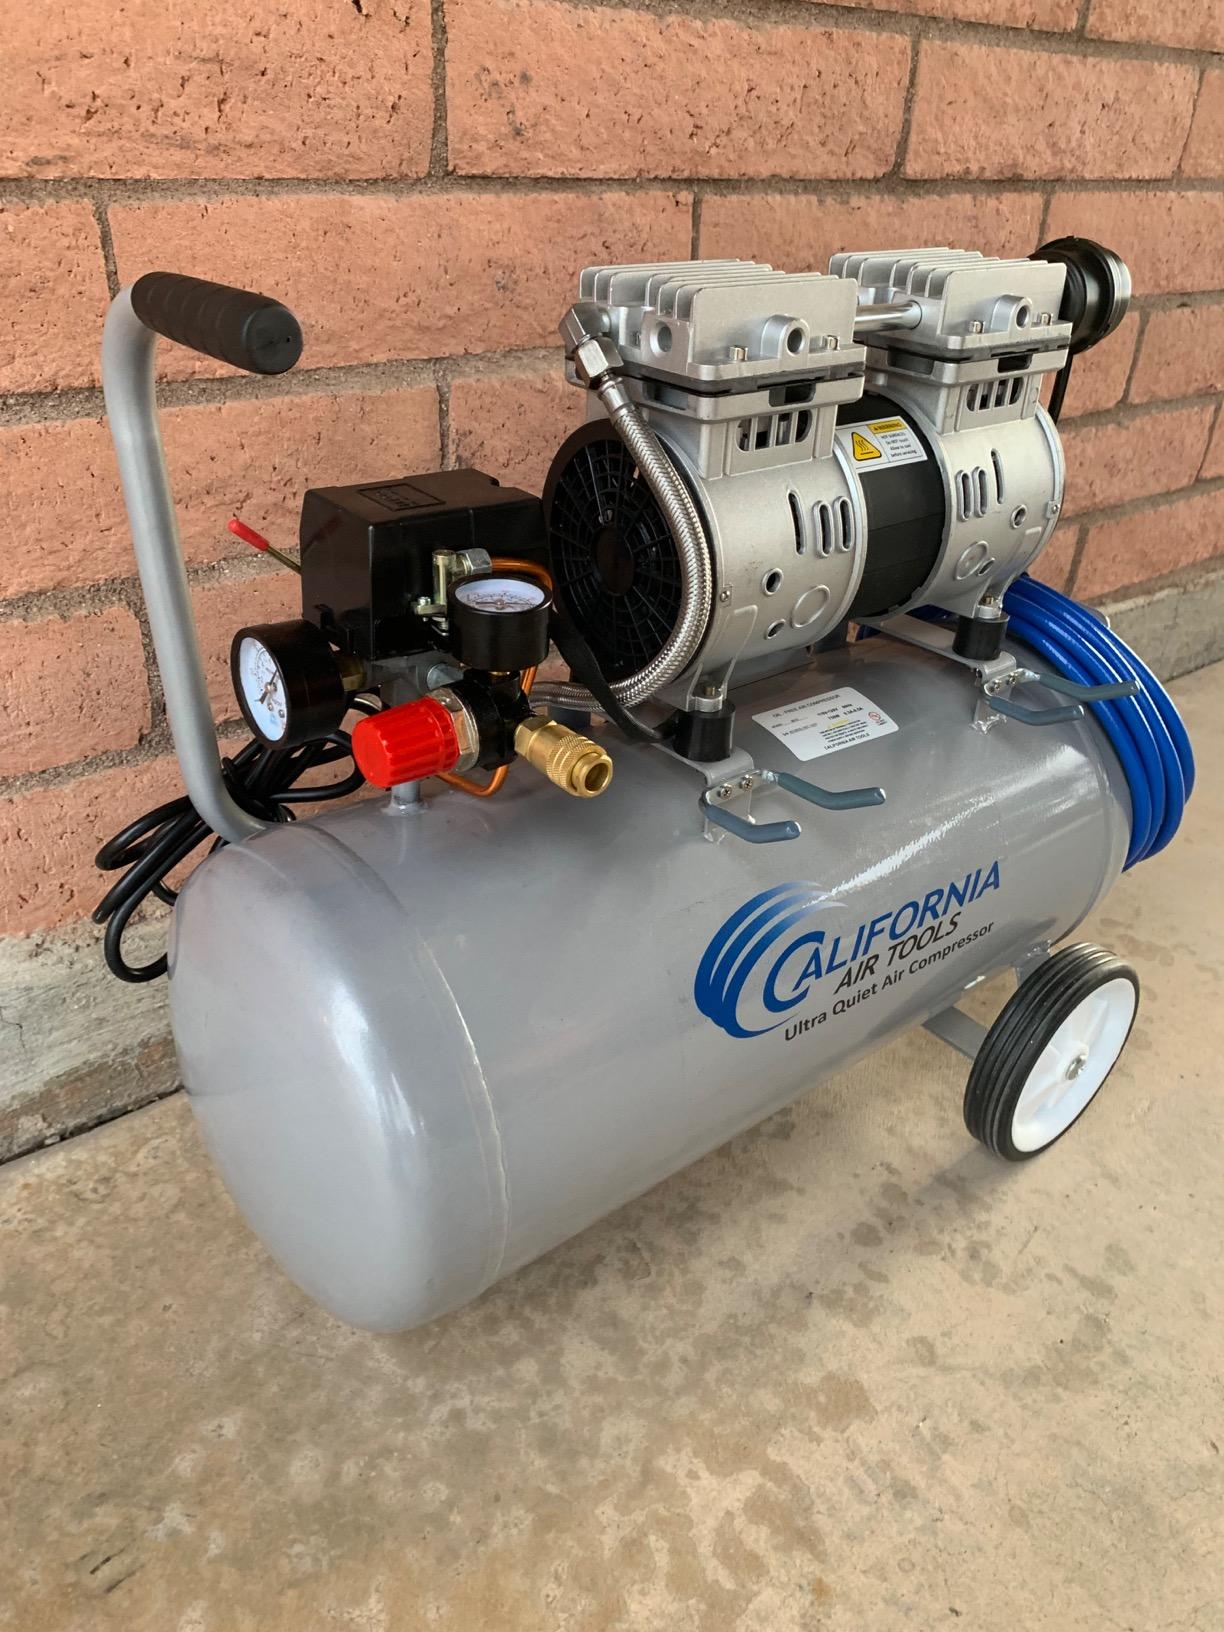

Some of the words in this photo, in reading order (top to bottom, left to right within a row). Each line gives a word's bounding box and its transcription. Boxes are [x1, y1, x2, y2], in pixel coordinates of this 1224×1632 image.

[763, 860, 1000, 1013] CALIFORNIA
[784, 1010, 827, 1041] Ultra
[832, 984, 878, 1015] Quiet
[881, 967, 904, 990] Air
[908, 921, 994, 975] Compressor
[834, 954, 880, 995] AIR
[887, 912, 961, 966] TOOLS
